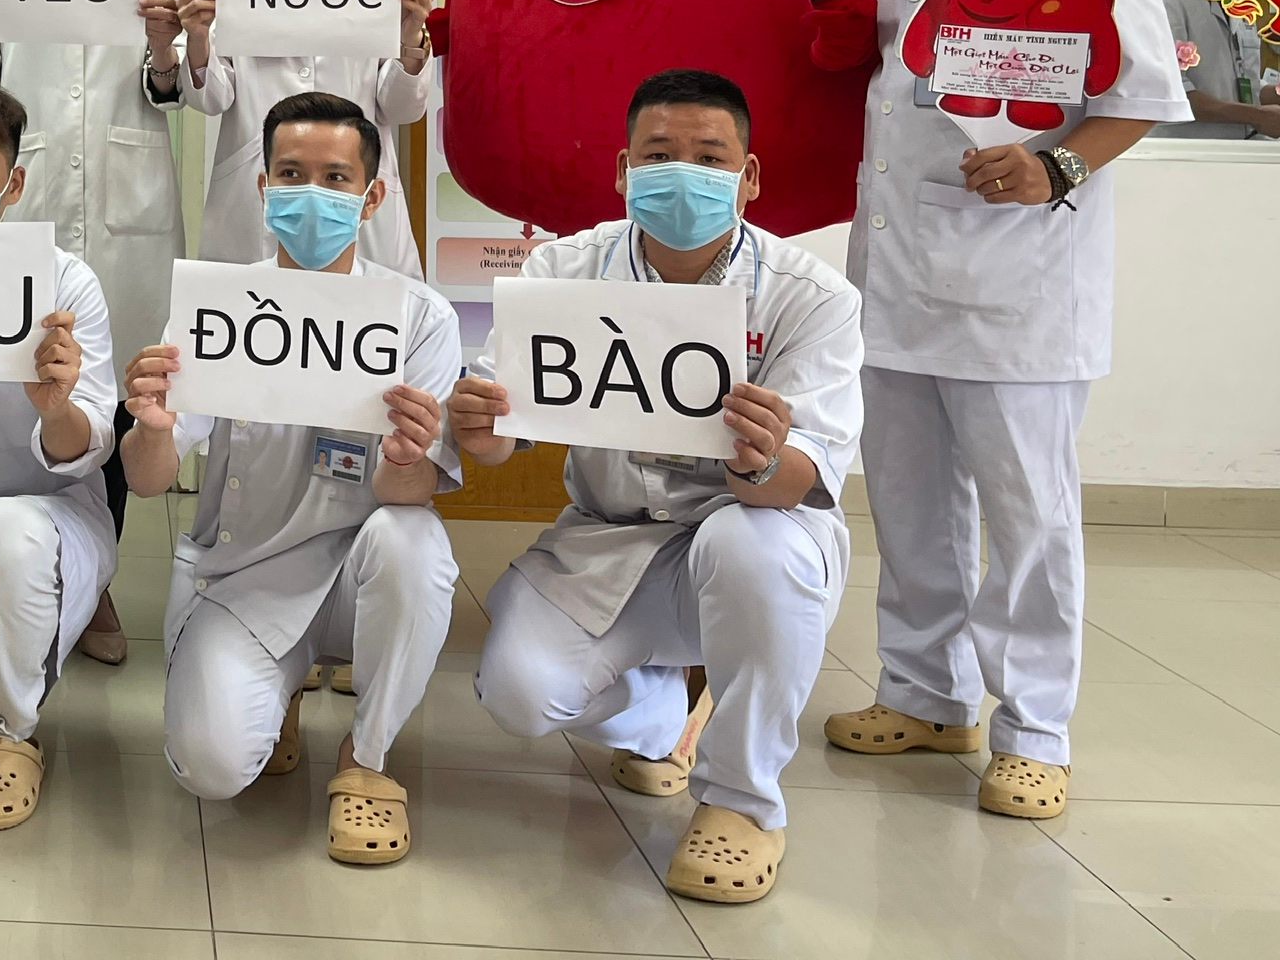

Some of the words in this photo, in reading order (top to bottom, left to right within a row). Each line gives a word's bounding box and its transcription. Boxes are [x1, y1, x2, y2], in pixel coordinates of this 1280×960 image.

[940, 26, 972, 40] BTH
[984, 32, 1003, 41] HIẾN
[1006, 34, 1023, 42] MÁU
[1048, 37, 1078, 46] NGUYỆN
[482, 246, 506, 257] Nhận
[508, 245, 526, 258] giấy
[189, 290, 399, 376] ĐỒNG
[530, 316, 731, 418] BÀO
